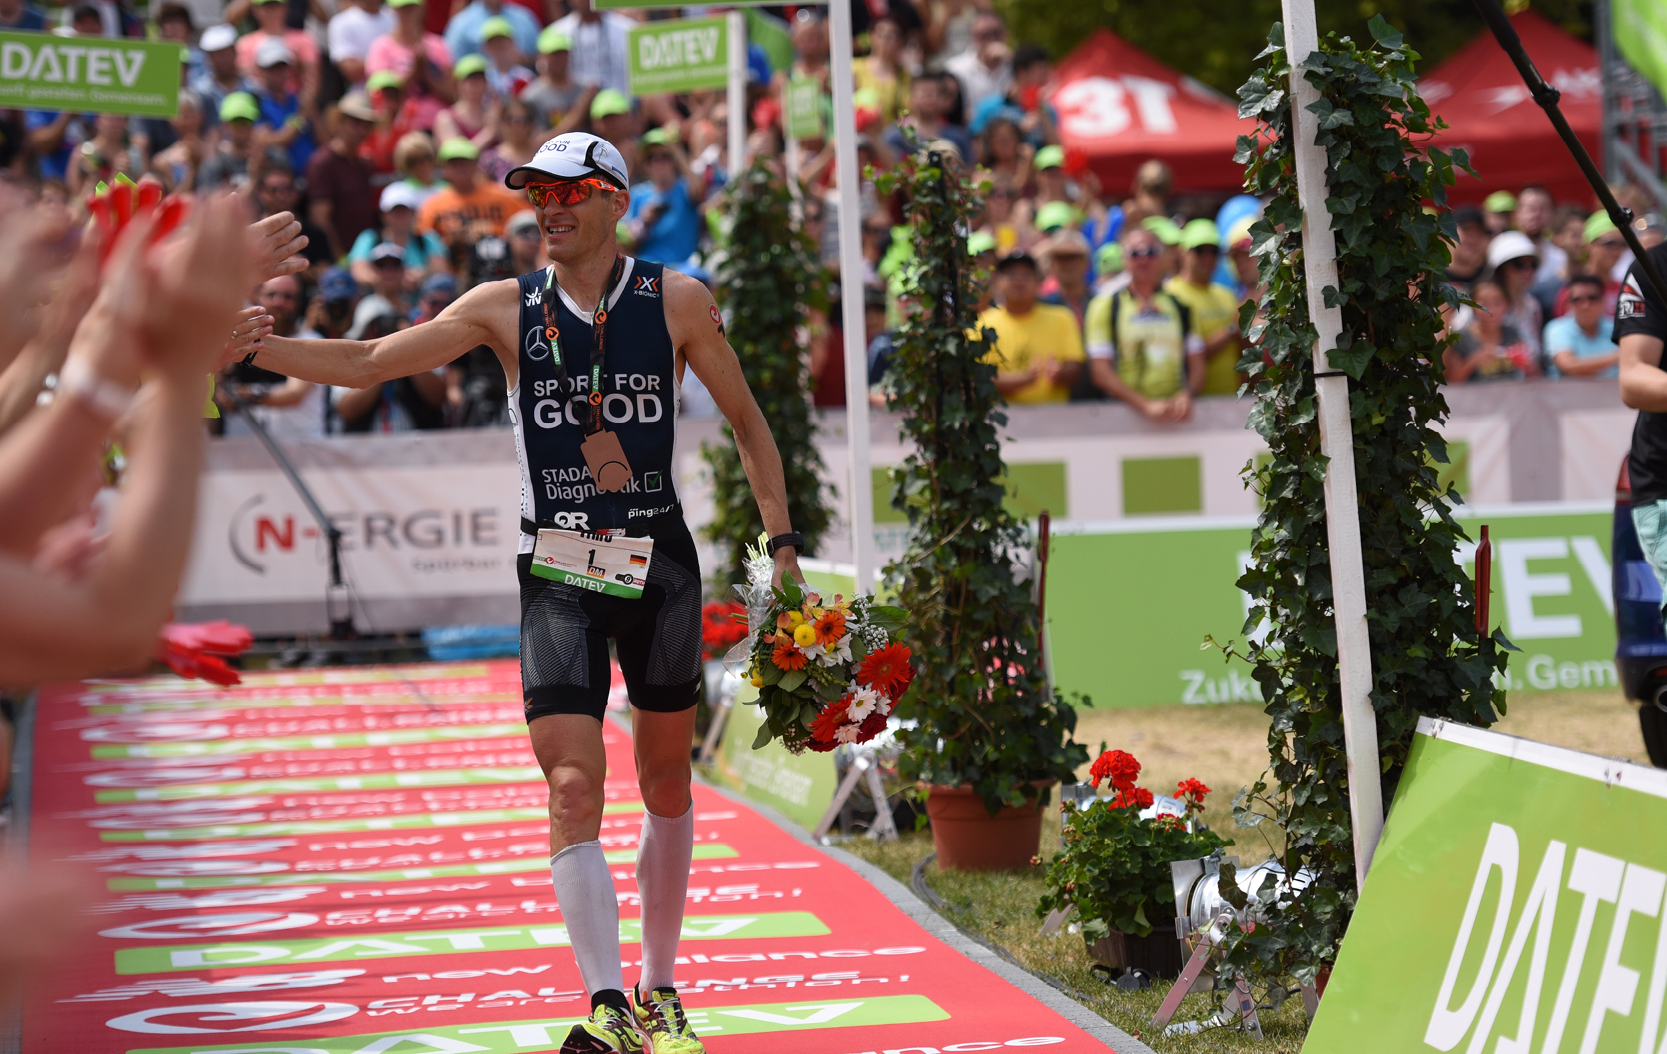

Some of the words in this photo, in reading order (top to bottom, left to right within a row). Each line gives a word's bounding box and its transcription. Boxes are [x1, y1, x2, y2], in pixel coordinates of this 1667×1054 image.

[1, 41, 147, 88] DATEV
[533, 374, 607, 397] SPOR
[614, 373, 661, 391] FOR
[533, 393, 663, 429] GOOD
[588, 549, 596, 565] 1
[564, 574, 606, 593] DATEV
[1424, 822, 1667, 1054] DATE
[382, 964, 552, 983] new
